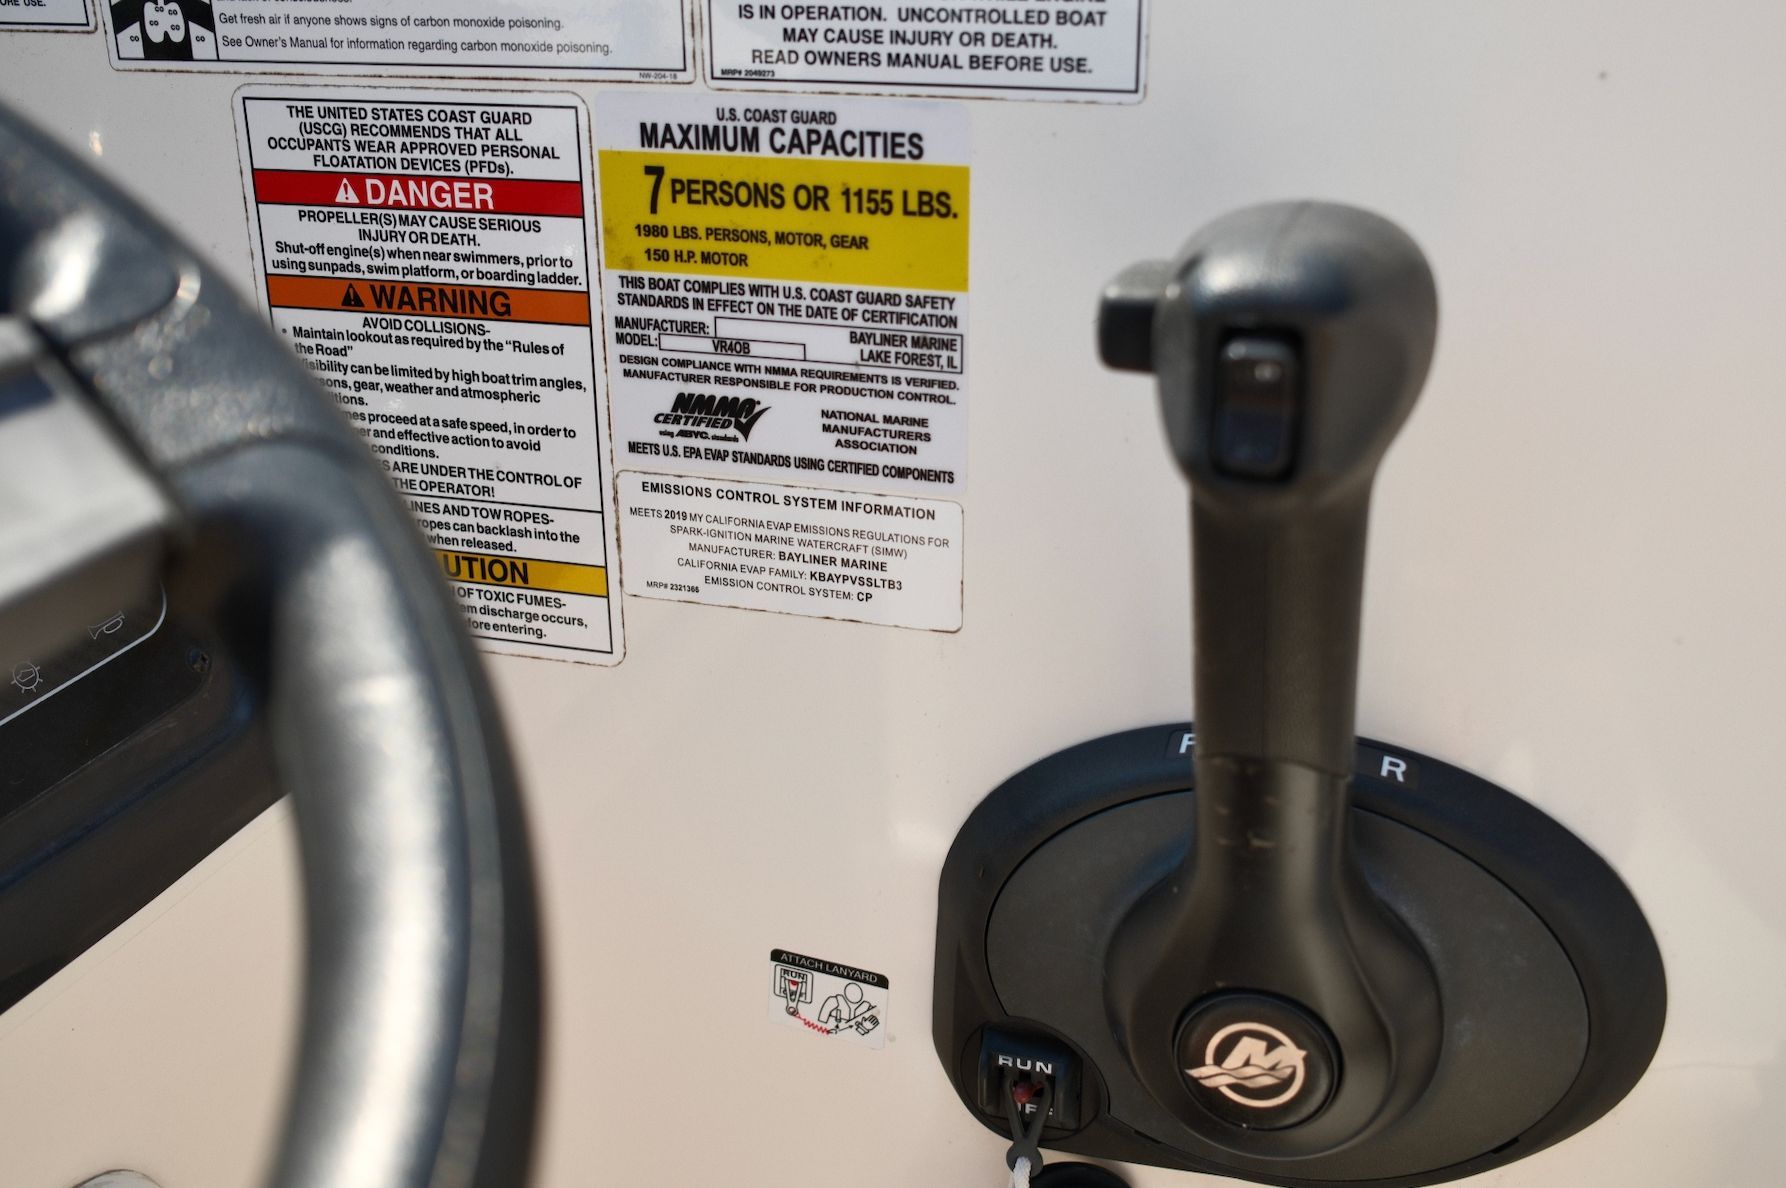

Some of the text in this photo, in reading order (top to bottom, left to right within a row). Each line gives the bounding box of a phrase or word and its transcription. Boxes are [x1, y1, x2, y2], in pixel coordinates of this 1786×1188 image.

[219, 13, 562, 29] Get fresh air if anyone shows signs of carbon monoxide poisoning.
[223, 36, 242, 46] See
[290, 37, 327, 48] Manual
[330, 38, 343, 48] for
[347, 38, 404, 49] information
[408, 40, 457, 53] regarding
[461, 40, 497, 51] carbon
[501, 42, 553, 52] monoxide
[557, 42, 612, 56] poisoning.
[783, 28, 1056, 48] MAY CAUSE INJURY OR DEATH.
[752, 50, 1091, 73] READ OWNERS MANUAL BEFORE USE.
[286, 106, 532, 124] THE UNITED STATES COAST GUARD
[717, 108, 836, 125] U.S. COAST GUARD
[298, 122, 522, 141] (USCG) RECOMMENDS THAT ALL
[640, 123, 923, 160] MAXIMUM CAPACITIES
[314, 155, 513, 176] FLOATATION DEVICES (PFDs).
[366, 179, 494, 209] DANGER
[644, 166, 957, 218] 7 PERSONS OR 1155 LBS.
[359, 229, 480, 246] INJURY OR DEATH.
[635, 224, 868, 249] 1980 LBS. PERSONS, MOTOR, GEAR
[276, 241, 572, 269] Shut-off engine(s) when near swimmers, prior to
[645, 249, 748, 266] 150 H.P. MOTOR
[369, 285, 511, 316] WARNING
[619, 276, 955, 310] THIS BOAT COMPLIES WITH U.S. COAST GUARD SAFETY
[363, 317, 490, 336] AVOID COLLISIONS-
[615, 316, 709, 336] MANUFACTURER:
[616, 333, 659, 349] MODEL:
[850, 331, 957, 351] BAYLINER MARINE
[859, 349, 957, 371] LAKE FOREST, IL
[620, 355, 958, 390] DESIGN COMPLIANCE WITH NMMA REQUIREMENTS IS VERIFIED.
[671, 392, 756, 419] NMMA
[654, 413, 733, 429] CERTIFIED
[822, 410, 928, 427] NATIONAL MARINE
[823, 424, 931, 441] MANUFACTURERS
[835, 439, 916, 454] ASSOCIATION
[393, 461, 418, 474] ARE
[421, 464, 468, 478] UNDER
[468, 468, 494, 480] THE
[497, 471, 562, 486] CONTROL
[564, 476, 581, 488] OF
[642, 482, 934, 520] EMISSIONS CONTROL SYSTEM INFORMATION
[416, 519, 579, 543] ropes can backlash into the
[630, 507, 949, 547] MEETS 2019 MY CALIFORNIA EVAP EMISSIONS REGULATIONS FOR
[689, 543, 886, 571] MANUFACTURER: BAYLINER MARINE
[444, 555, 528, 584] UTION
[678, 558, 737, 571] CALIFORNIA
[740, 565, 765, 574] EVAP
[769, 568, 806, 579] FAMILY:
[705, 576, 872, 601] EMISSION CONTROL SYSTEM: CP
[1381, 756, 1406, 781] R
[781, 953, 877, 982] ATTACH LANYARD
[999, 1056, 1052, 1074] RUN
